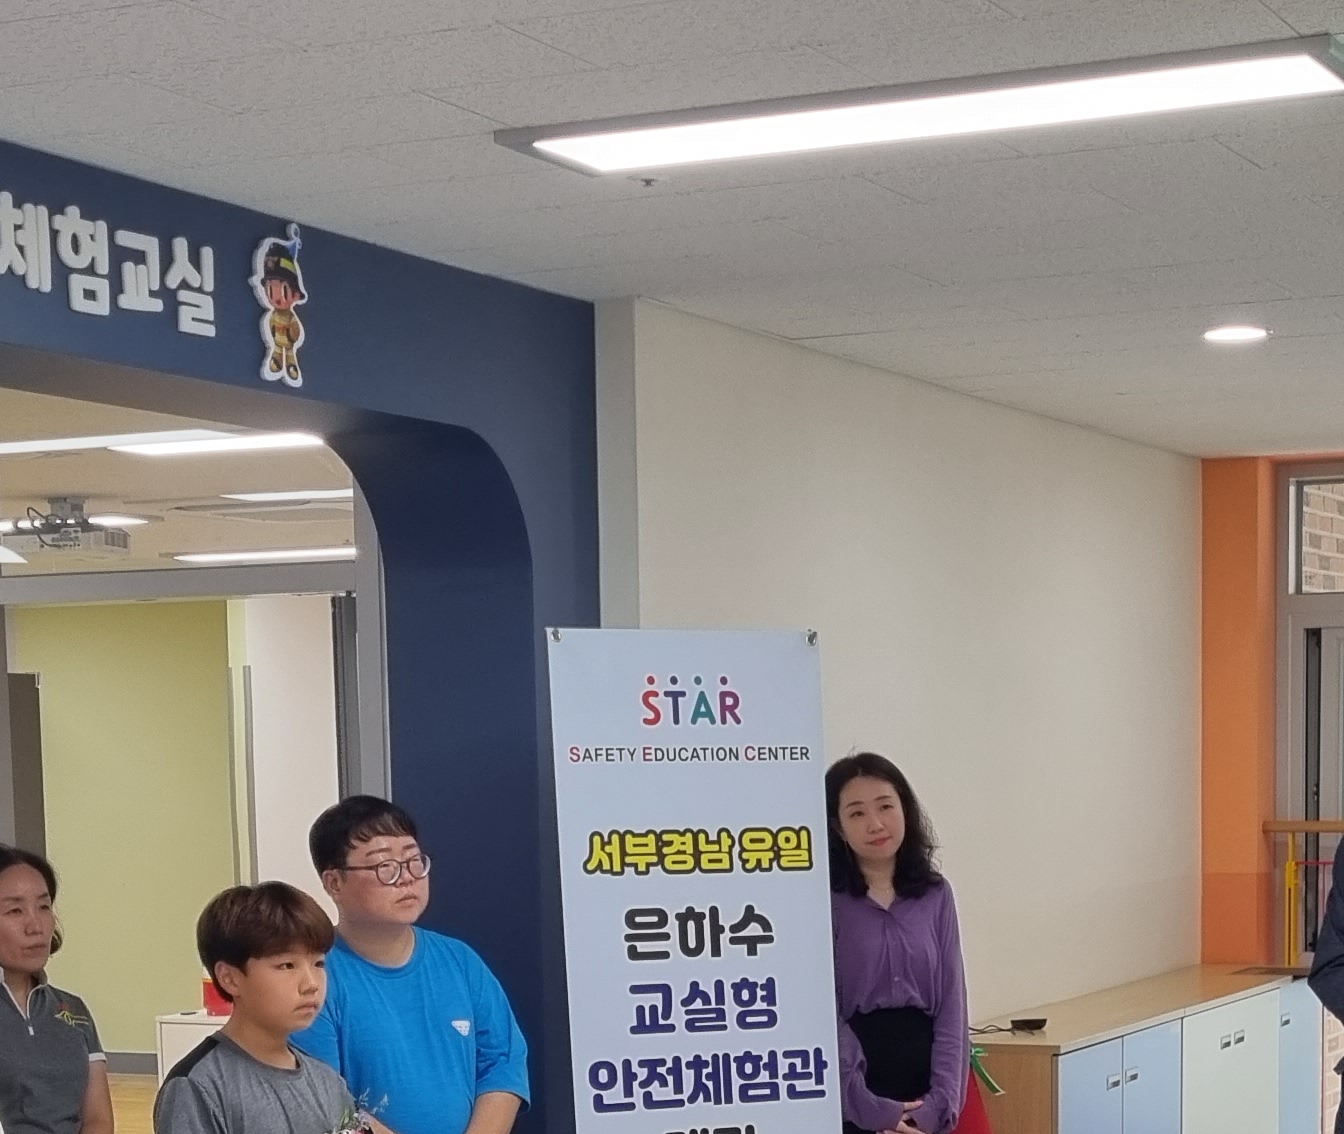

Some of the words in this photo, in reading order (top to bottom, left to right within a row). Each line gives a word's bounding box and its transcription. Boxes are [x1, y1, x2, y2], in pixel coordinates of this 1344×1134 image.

[641, 689, 743, 727] STAR
[569, 746, 637, 762] SAFETY
[642, 746, 739, 762] EDUCATION
[744, 745, 810, 761] CENTER
[583, 830, 734, 876] 서부경남
[739, 826, 814, 873] 유일
[624, 905, 774, 961] 은하수
[629, 977, 777, 1034] 교실형
[589, 1047, 828, 1113] 안전체험관
